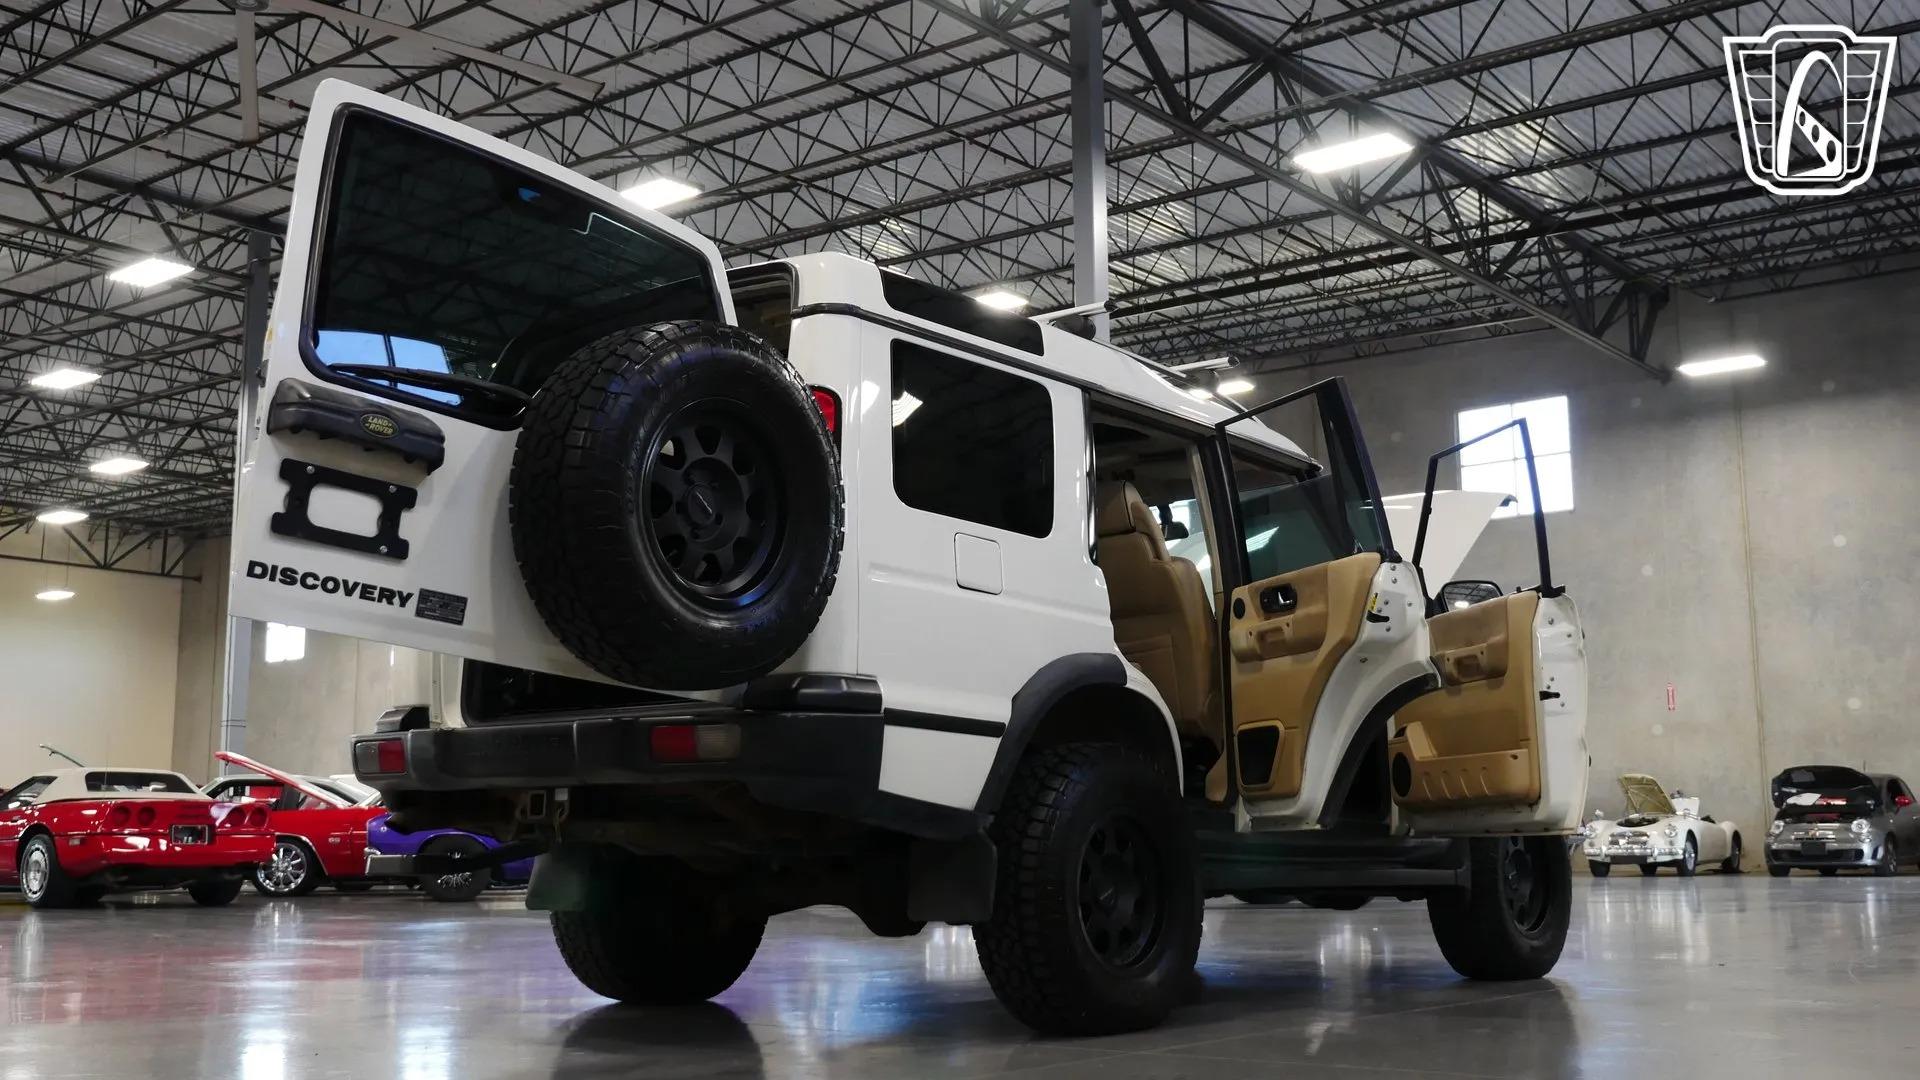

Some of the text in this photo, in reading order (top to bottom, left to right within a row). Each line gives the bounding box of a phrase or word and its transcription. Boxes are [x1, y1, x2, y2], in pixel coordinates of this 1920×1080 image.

[368, 416, 389, 427] LAND
[369, 423, 394, 435] ROVER
[246, 559, 414, 608] DISCOVERY
